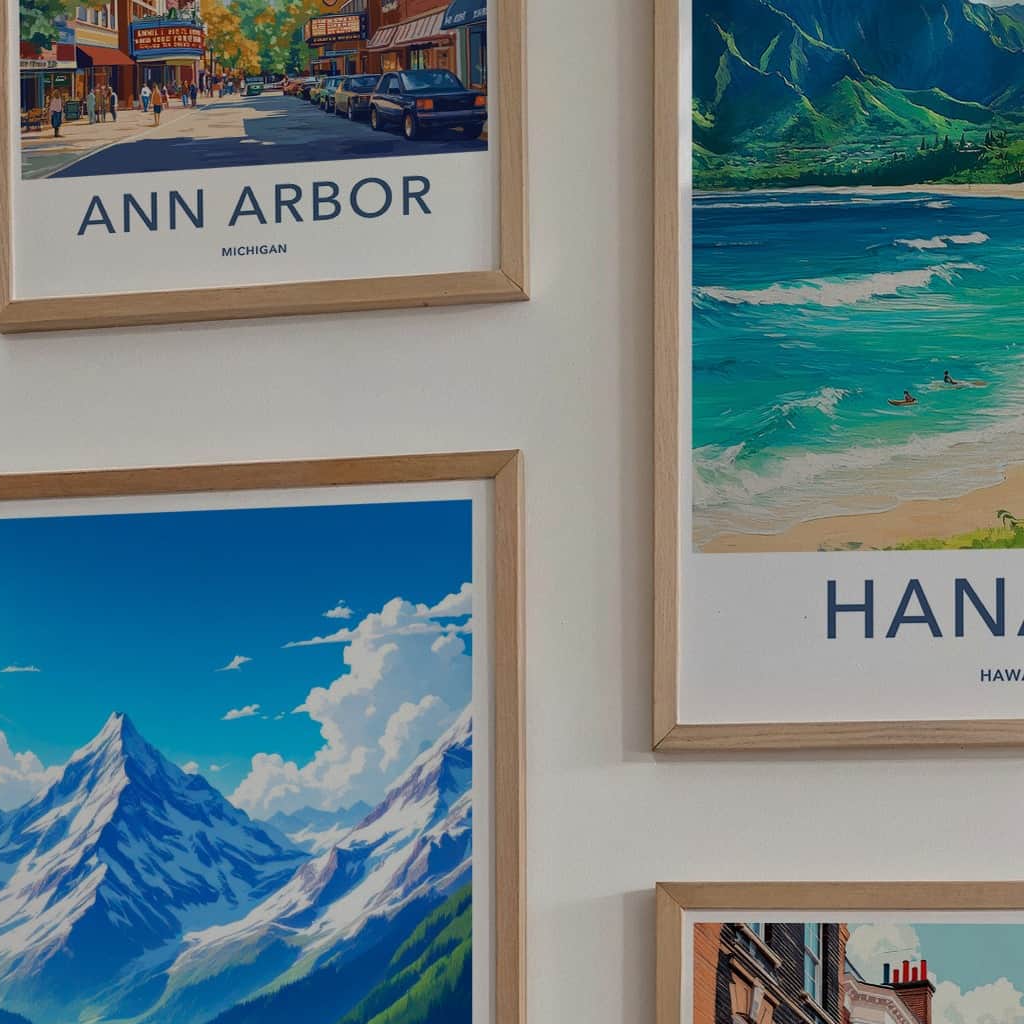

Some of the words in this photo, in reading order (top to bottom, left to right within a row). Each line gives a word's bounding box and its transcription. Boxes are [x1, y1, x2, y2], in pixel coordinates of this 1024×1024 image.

[77, 188, 204, 236] ANN
[228, 175, 432, 227] ARBOR
[221, 244, 287, 257] MICHIGAN
[827, 577, 1024, 639] HAN
